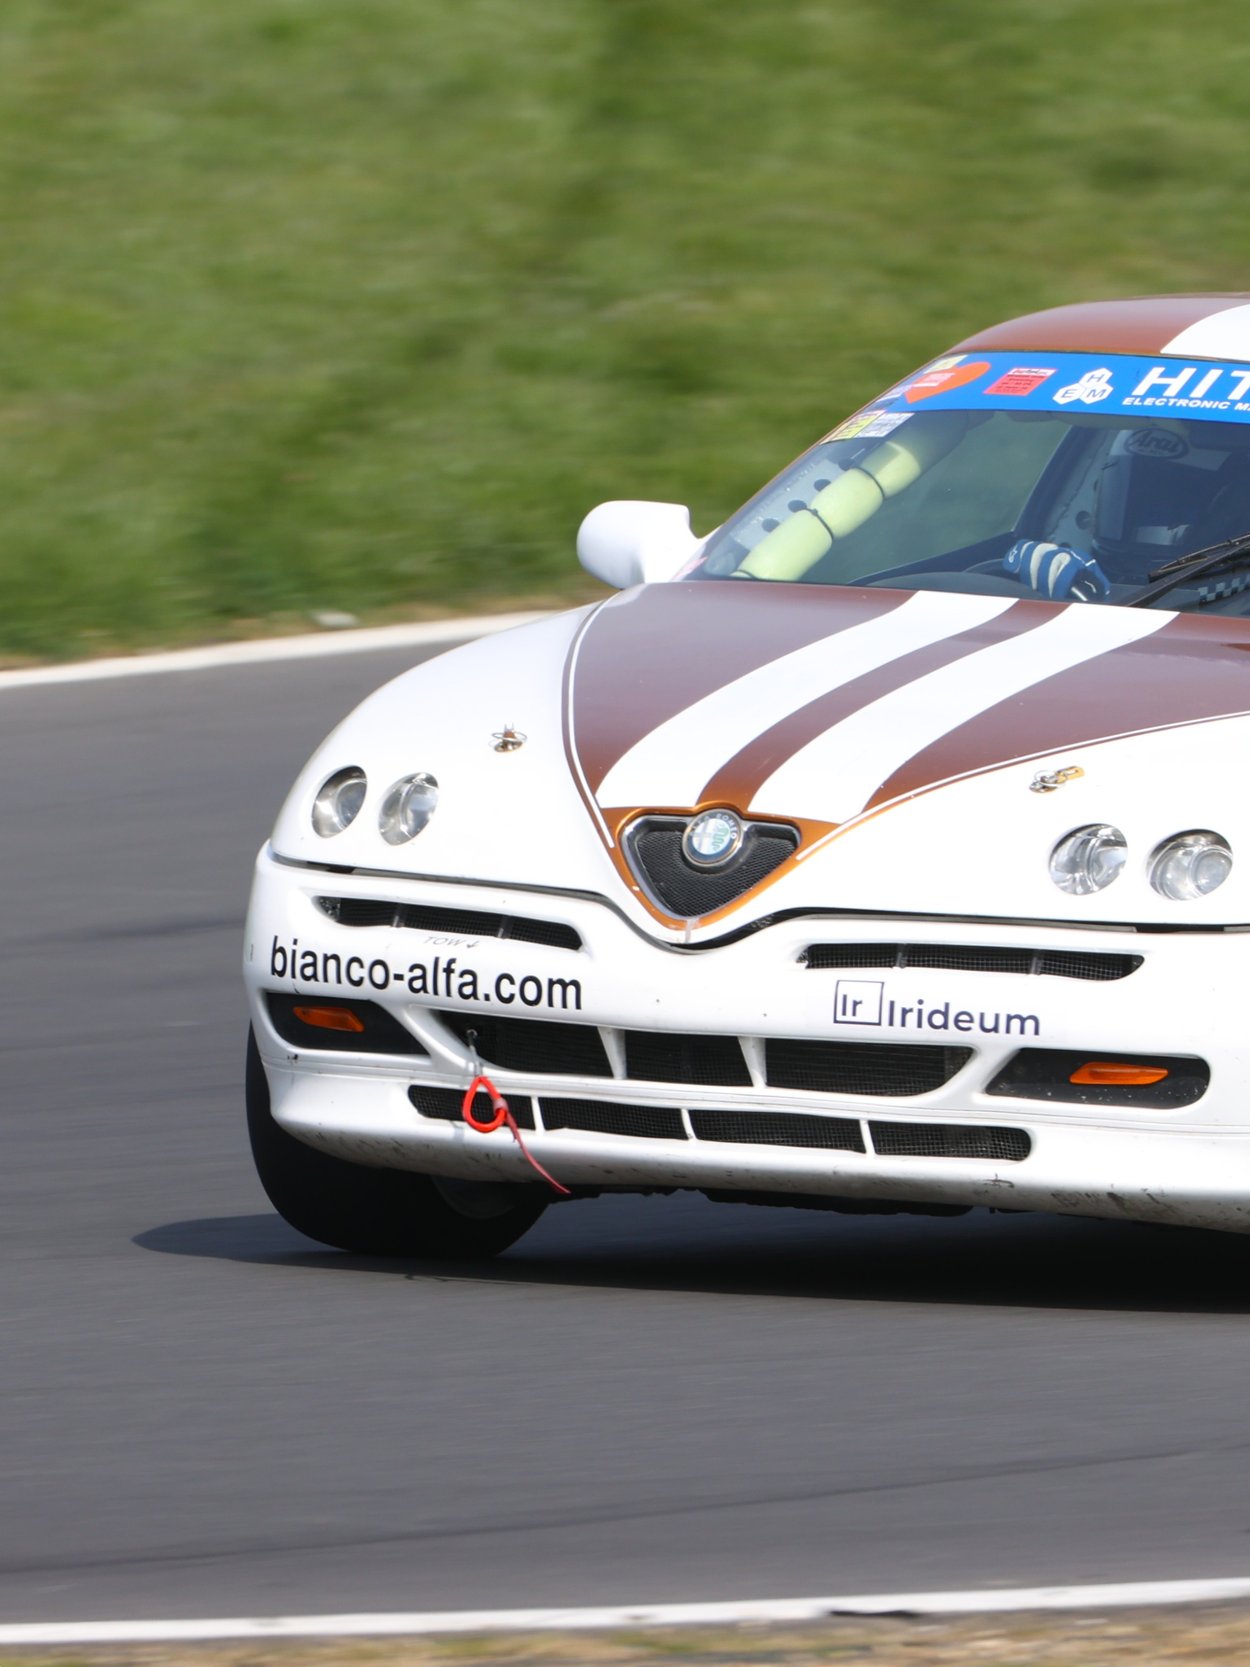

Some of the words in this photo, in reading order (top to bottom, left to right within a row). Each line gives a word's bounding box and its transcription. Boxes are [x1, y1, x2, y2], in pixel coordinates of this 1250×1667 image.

[1122, 396, 1231, 411] ELECTRONIC
[270, 935, 583, 1010] bianco-alfa.com
[888, 998, 1040, 1036] Irideum
